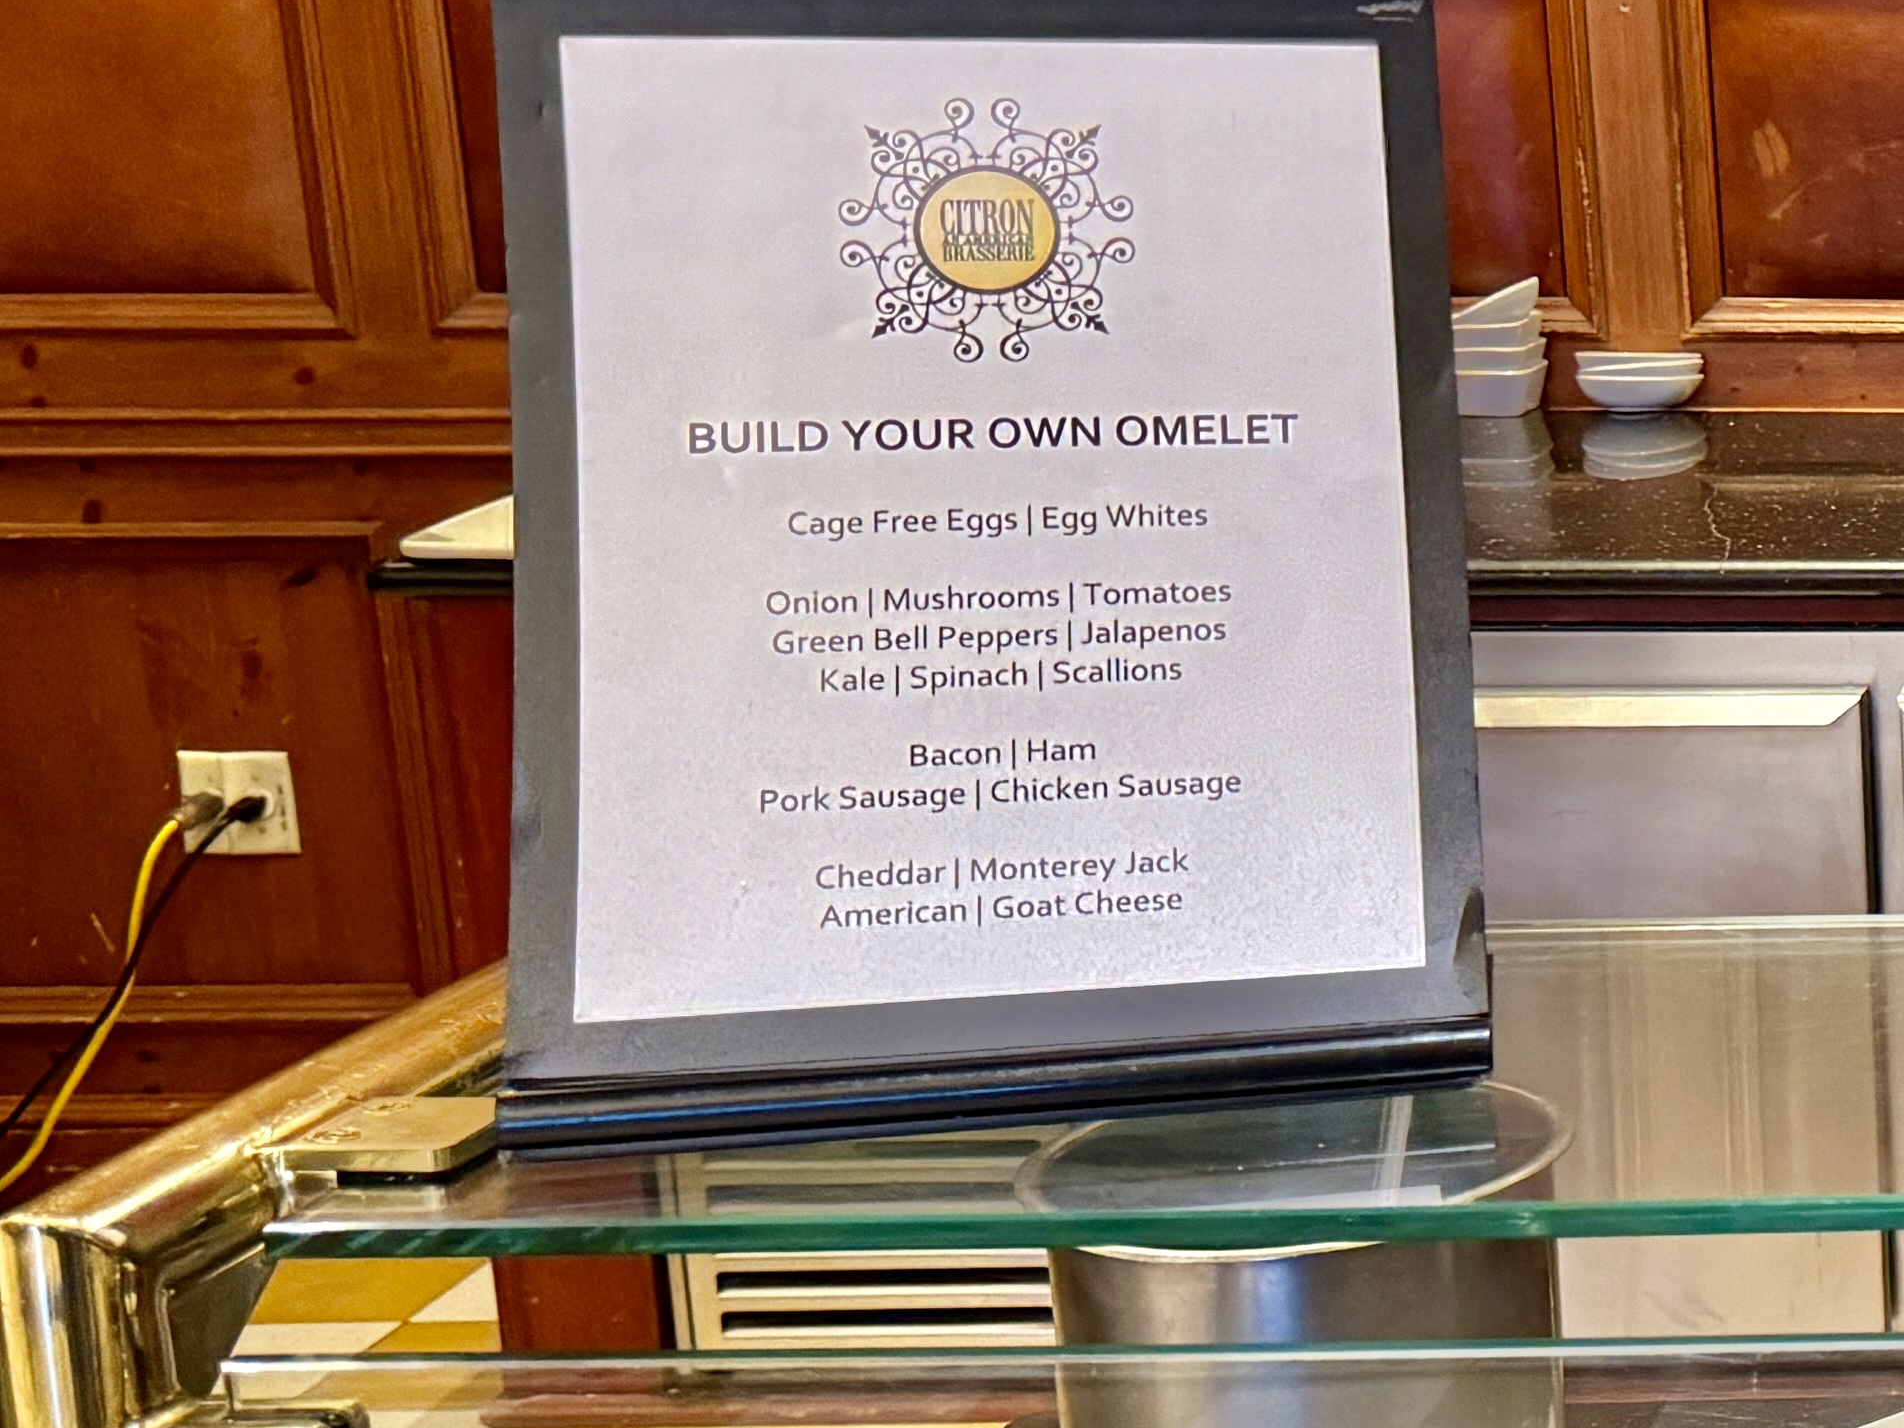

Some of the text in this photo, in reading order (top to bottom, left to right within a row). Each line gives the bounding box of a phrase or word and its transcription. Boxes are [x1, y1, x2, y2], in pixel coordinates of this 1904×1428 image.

[939, 198, 1035, 235] CITRON
[943, 244, 1035, 262] BRASSERIE
[688, 413, 1299, 454] BUILD YOUR OWN OMELET
[788, 502, 1208, 542] Cage Free Eggs Egg Whites
[766, 582, 1232, 616] Onion Mushrooms Tomatoes
[772, 618, 1227, 656] Green Bell Peppers Jalapenos
[820, 656, 1183, 697] Kale Spinach Scallions
[909, 738, 1097, 768] Bacon Ham
[760, 773, 1242, 814] Pork Sausage Chicken Sausage
[815, 846, 1189, 890] Cheddar Monterey Jack
[819, 888, 1183, 930] American Goat Cheese
